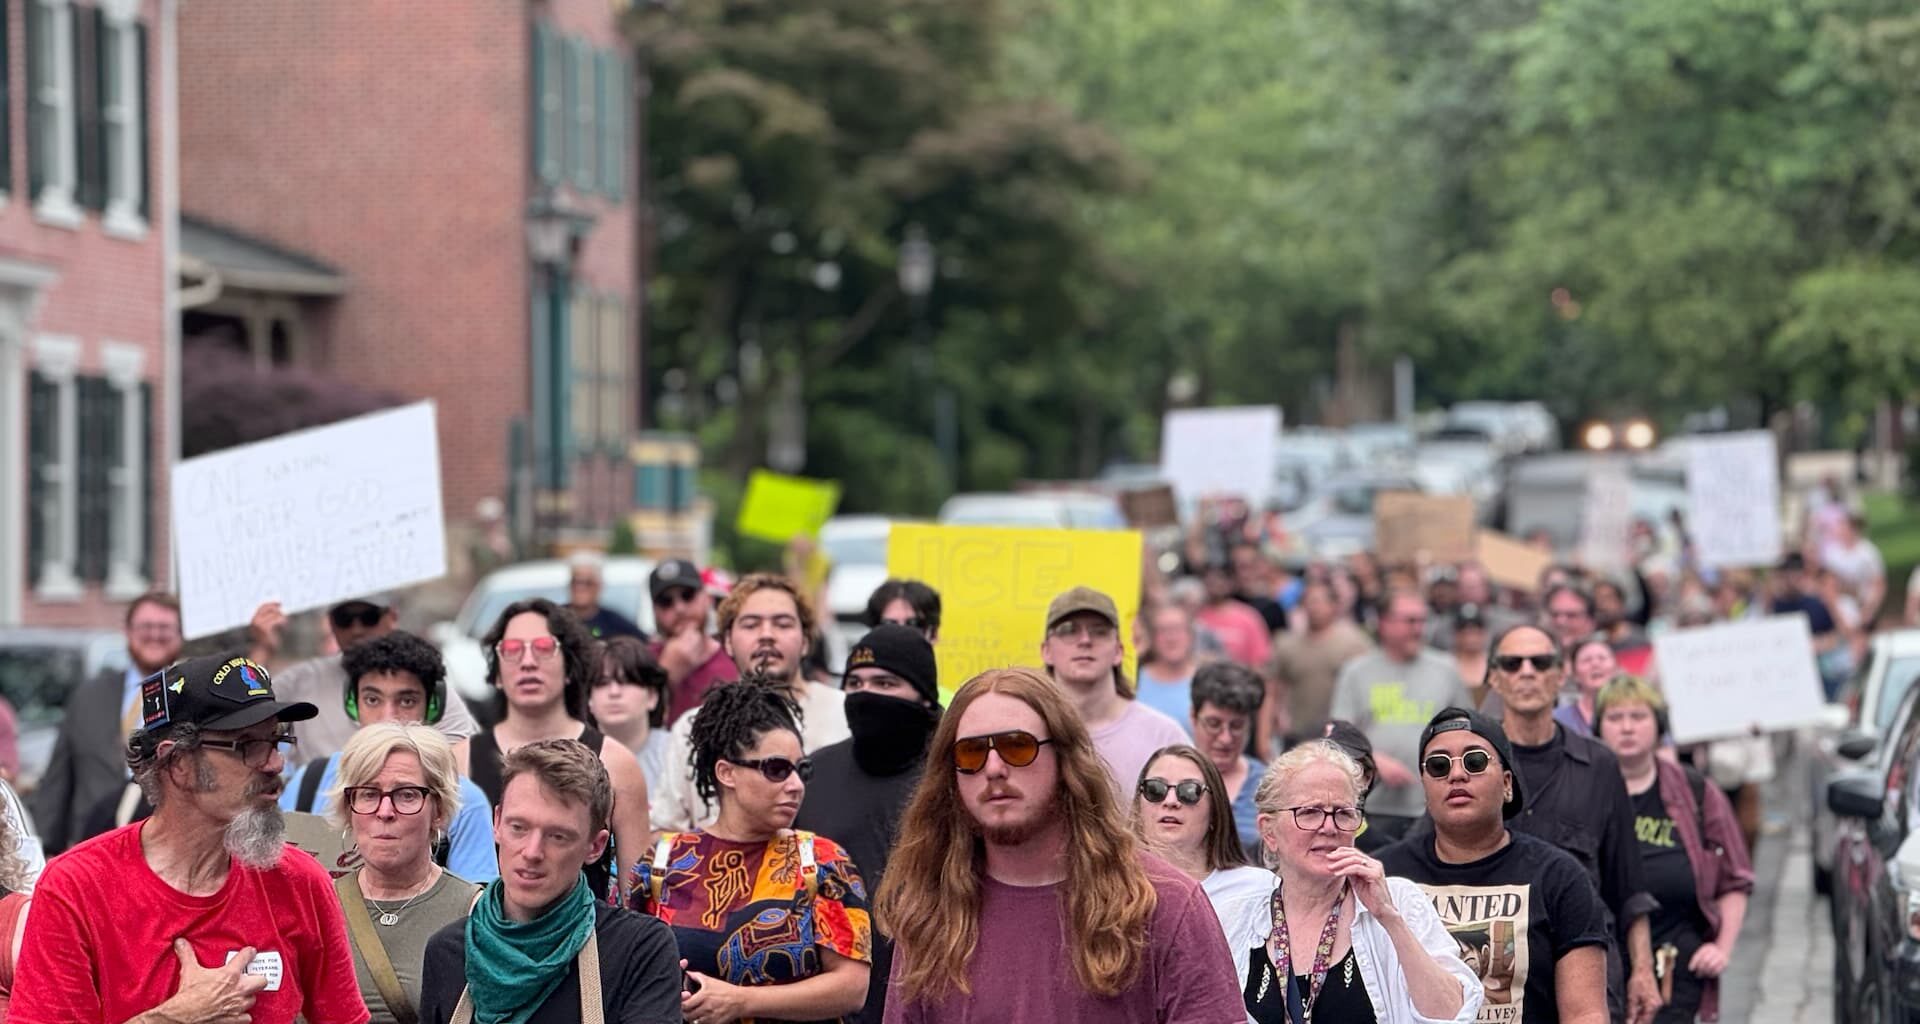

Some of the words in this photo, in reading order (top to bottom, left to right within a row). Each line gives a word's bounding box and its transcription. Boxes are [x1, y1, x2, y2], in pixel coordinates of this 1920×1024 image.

[315, 478, 384, 520] GOD
[916, 535, 1079, 611] ICE
[213, 664, 231, 685] COLD
[1426, 893, 1521, 922] ANTED
[1476, 1007, 1511, 1022] LIVE
